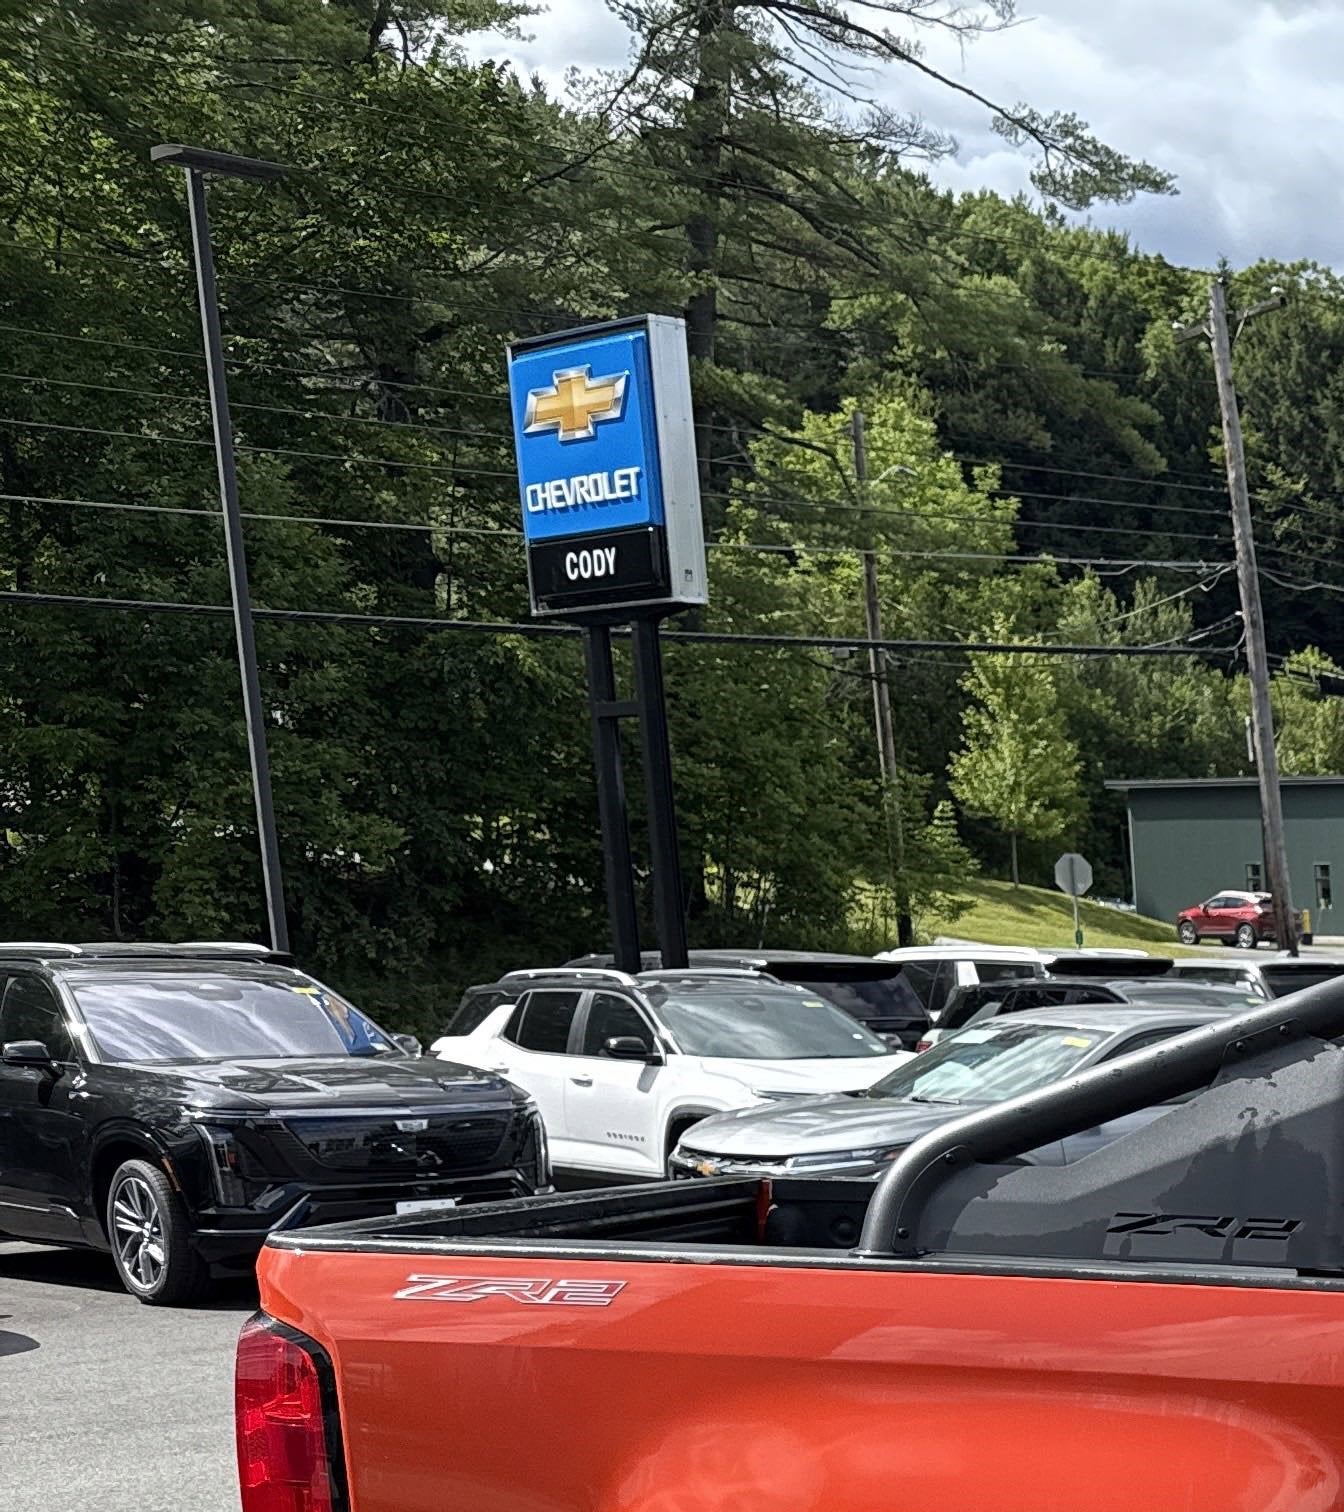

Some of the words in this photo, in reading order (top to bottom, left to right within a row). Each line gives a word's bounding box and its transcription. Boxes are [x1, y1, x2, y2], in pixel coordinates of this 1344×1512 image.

[525, 465, 641, 513] CHEVROLET
[565, 546, 617, 581] CODY
[1105, 1211, 1303, 1241] ZR2
[393, 1272, 629, 1307] ZR2
